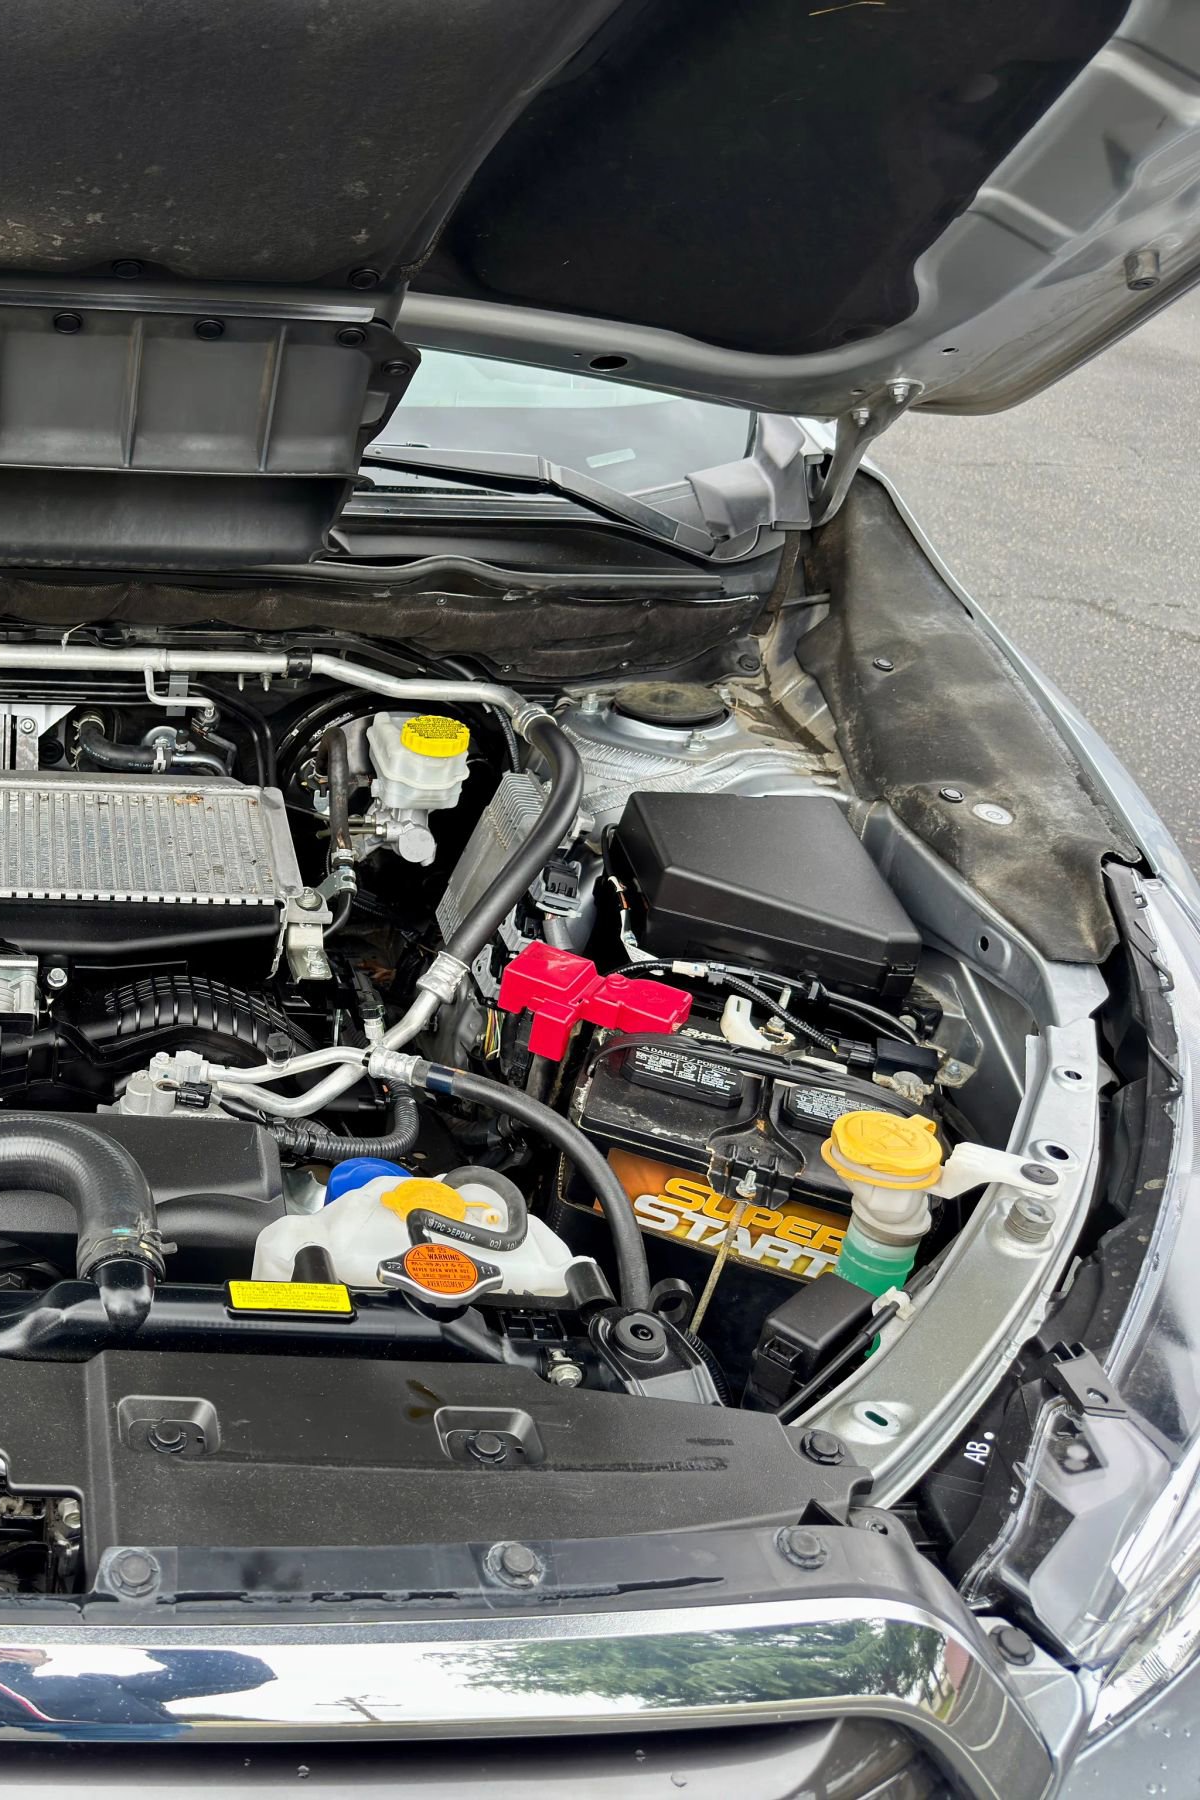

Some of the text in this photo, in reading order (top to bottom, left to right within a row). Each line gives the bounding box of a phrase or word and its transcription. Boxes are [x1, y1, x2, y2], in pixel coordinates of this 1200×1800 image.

[651, 1047, 688, 1061] DANGER
[657, 1178, 847, 1255] SUPER
[634, 1194, 839, 1279] START
[427, 1253, 460, 1261] WARNING
[963, 1441, 990, 1466] AB
